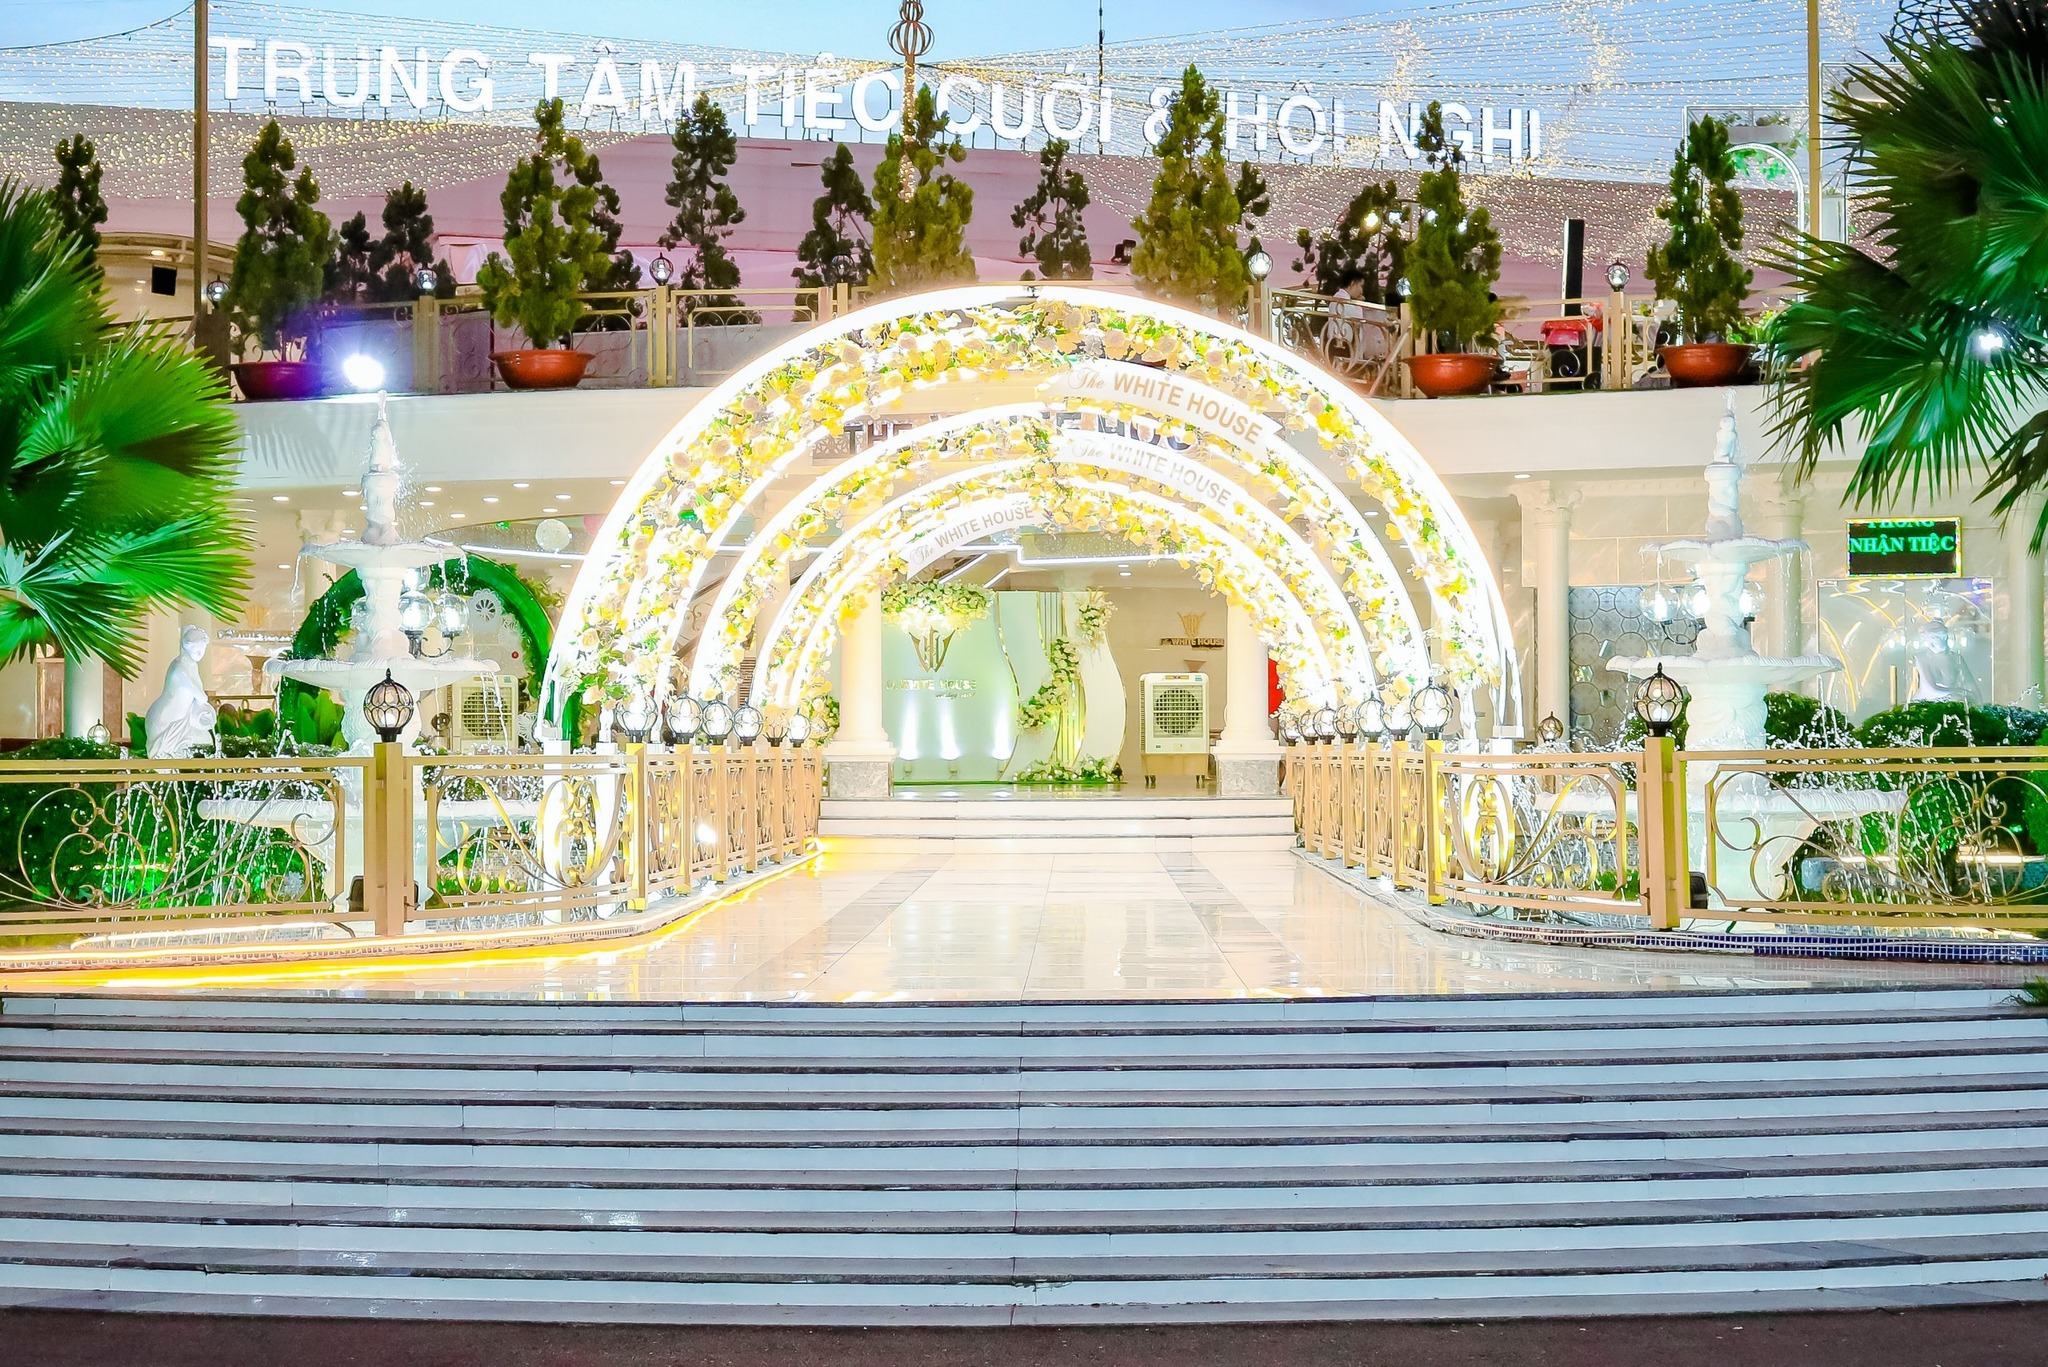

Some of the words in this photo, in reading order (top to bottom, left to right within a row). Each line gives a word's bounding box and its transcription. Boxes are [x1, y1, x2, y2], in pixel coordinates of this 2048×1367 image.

[207, 36, 494, 113] TRUNG
[525, 38, 697, 123] TÂM
[1068, 367, 1105, 390] The
[1113, 371, 1185, 407] WHITE
[1187, 392, 1263, 445] HOUSE
[1072, 439, 1105, 458] The
[1110, 442, 1169, 474] WHITE
[1169, 462, 1232, 507] HOUSE
[910, 544, 935, 564] The
[934, 518, 981, 547] WHITE
[981, 506, 1035, 528] HOUSE
[1850, 533, 1905, 556] NHẬN
[1908, 532, 1955, 555] TIỆC
